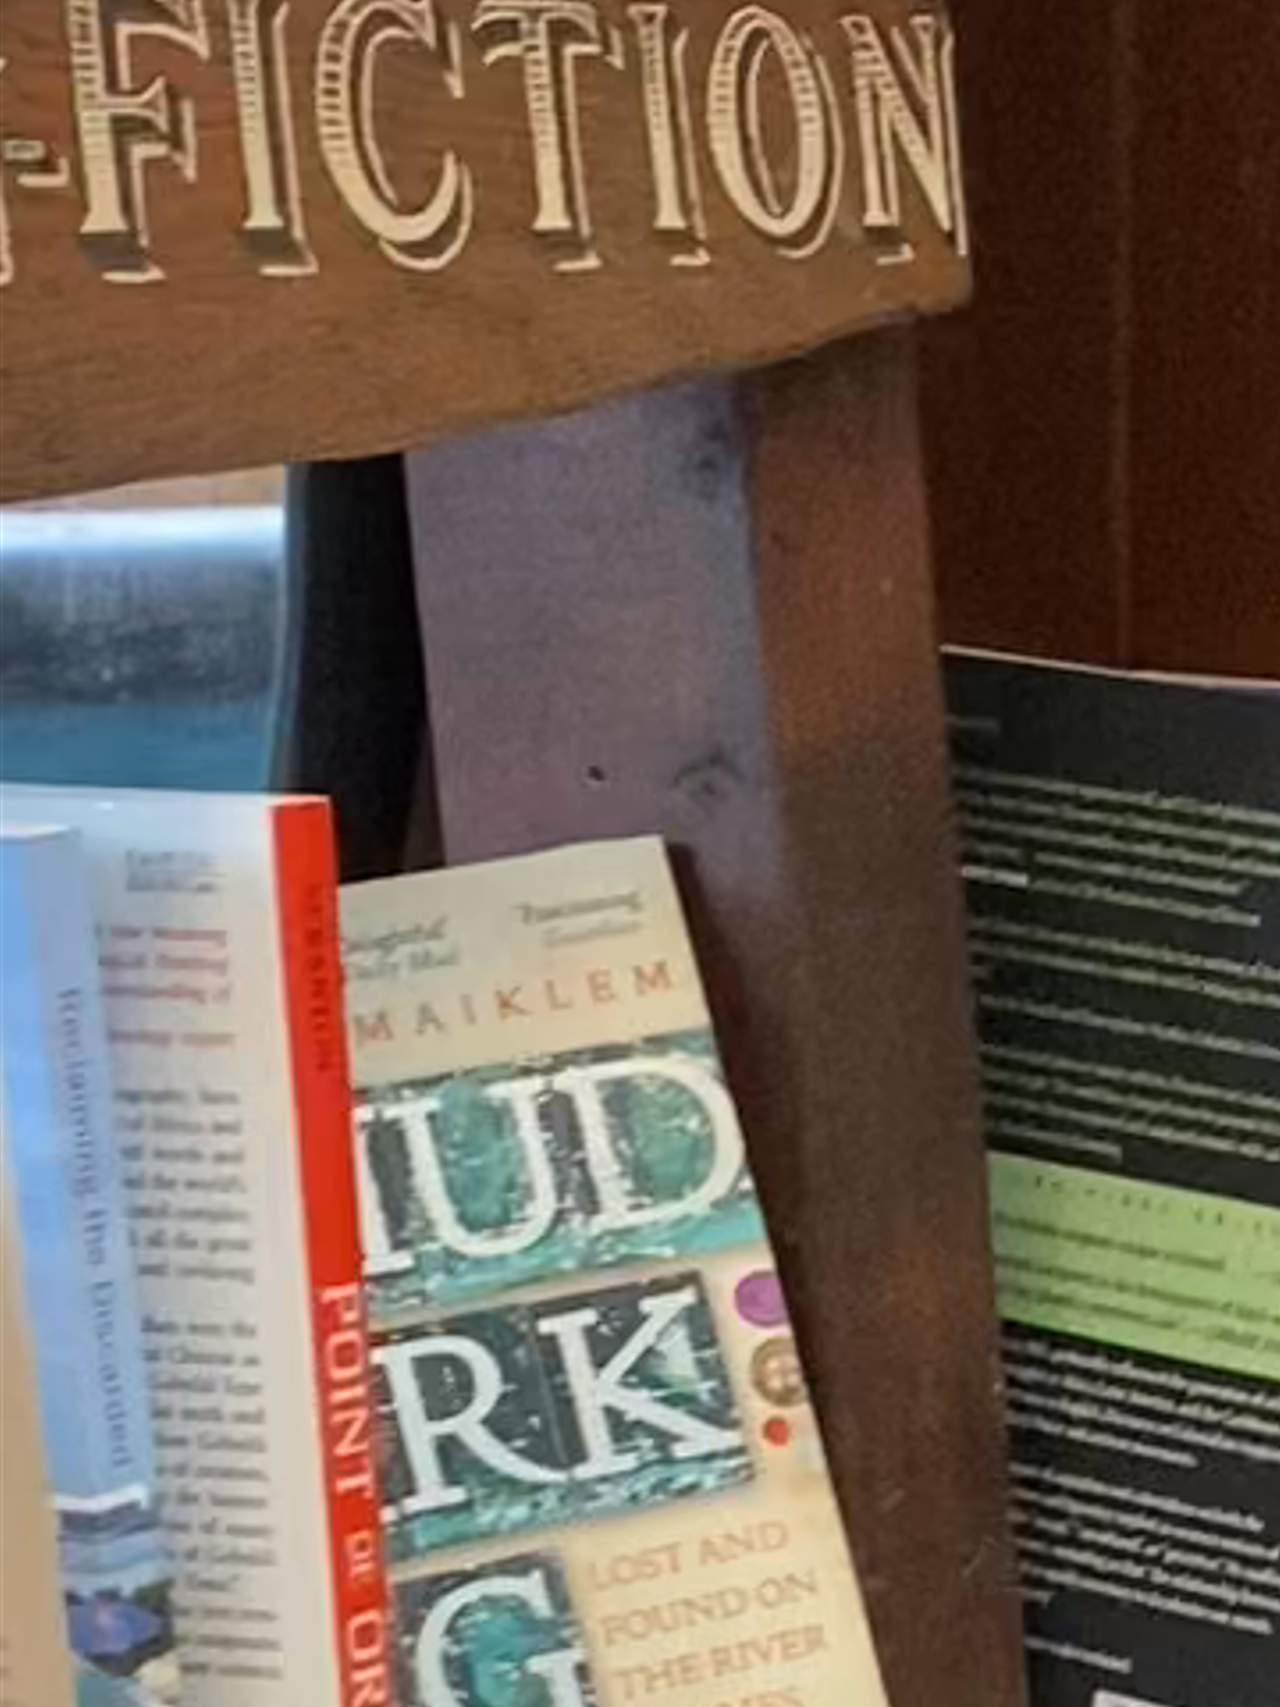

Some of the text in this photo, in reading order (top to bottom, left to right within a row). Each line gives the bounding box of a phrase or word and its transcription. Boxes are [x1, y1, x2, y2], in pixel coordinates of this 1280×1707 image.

[353, 960, 674, 1047] MAIKLEM
[56, 987, 134, 1471] Reclaiming the Discarded
[318, 1279, 375, 1502] POINT
[370, 1286, 746, 1521] RK
[344, 1527, 379, 1587] OF
[588, 1519, 790, 1590] LOST AND
[602, 1565, 818, 1648] FOUND ON
[614, 1622, 827, 1701] THE RIVER
